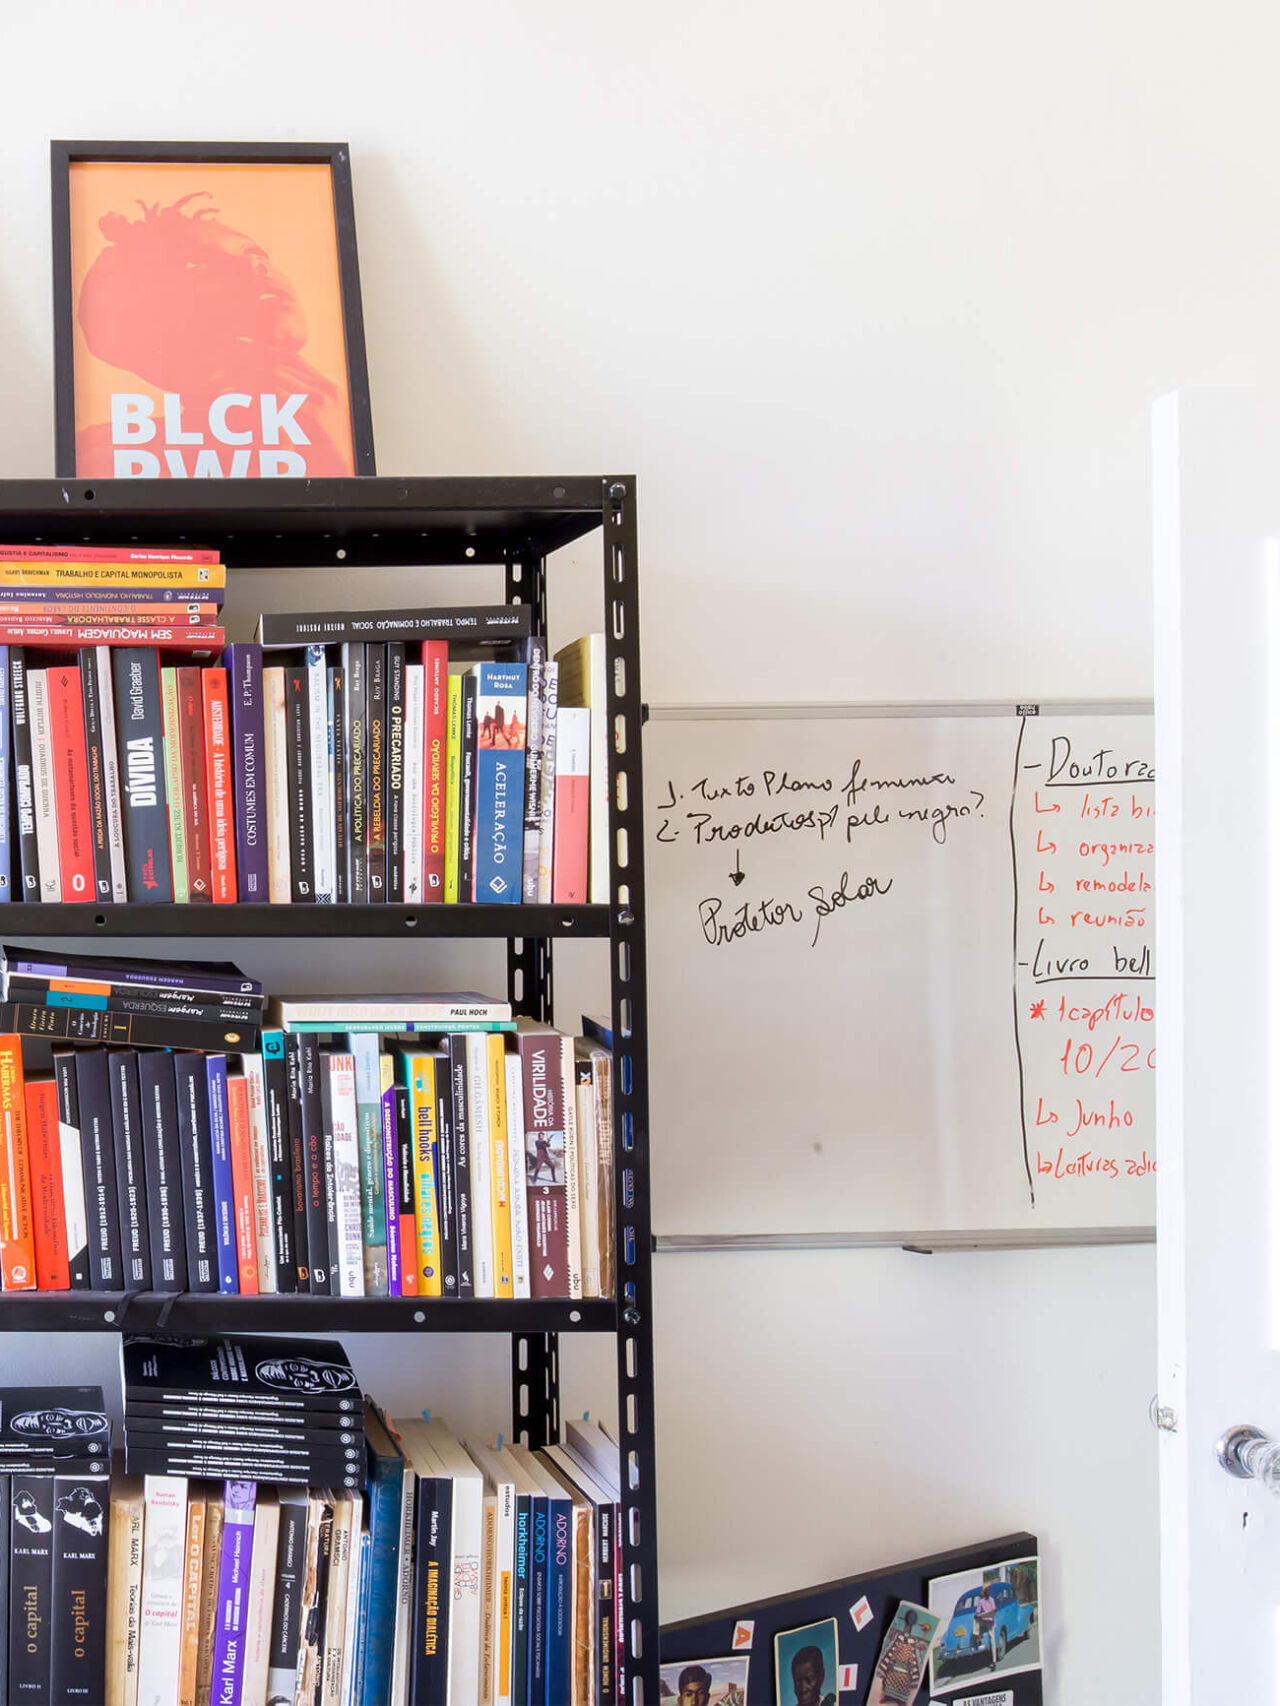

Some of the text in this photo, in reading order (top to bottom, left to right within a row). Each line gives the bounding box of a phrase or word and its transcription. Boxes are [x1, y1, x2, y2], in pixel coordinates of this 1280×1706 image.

[111, 393, 311, 445] BLCK
[131, 571, 183, 580] MONOPOLISTA
[78, 628, 173, 639] SEM MAQUIAGEM
[12, 660, 33, 835] TEMPO COMPRADO WOLFGANG STREECK
[125, 662, 157, 808] DÍVIDA David Graeber
[391, 667, 402, 790] STANDING O PRECARIADO
[244, 733, 258, 846] COSTUMES EM COMUM
[351, 720, 362, 834] POLÍTICA PRECARIADO
[371, 719, 382, 834] REBELDIA PRECARIADO
[429, 739, 441, 844] PRIVILÉGIO SERVIDÃO
[492, 761, 508, 864] ACELERAÇÃO
[699, 898, 803, 945] Protetor
[1071, 907, 1146, 927] reunião
[1113, 945, 1151, 976] bell
[450, 1008, 488, 1016] PAUL HOCH
[0, 1050, 13, 1109] HABERMAS
[531, 1049, 548, 1128] VIRILIDADE
[418, 1106, 432, 1162] bell hooks
[1066, 1099, 1134, 1137] Junho
[516, 1512, 529, 1580] horkheimer
[534, 1512, 546, 1563] ADORNO
[556, 1513, 567, 1566] ADORNO
[24, 1586, 41, 1639] capital
[71, 1590, 89, 1644] capital
[424, 1568, 440, 1656] IMAGINAÇÃO DIALÉTICA
[221, 1640, 238, 1705] Karl Marx
